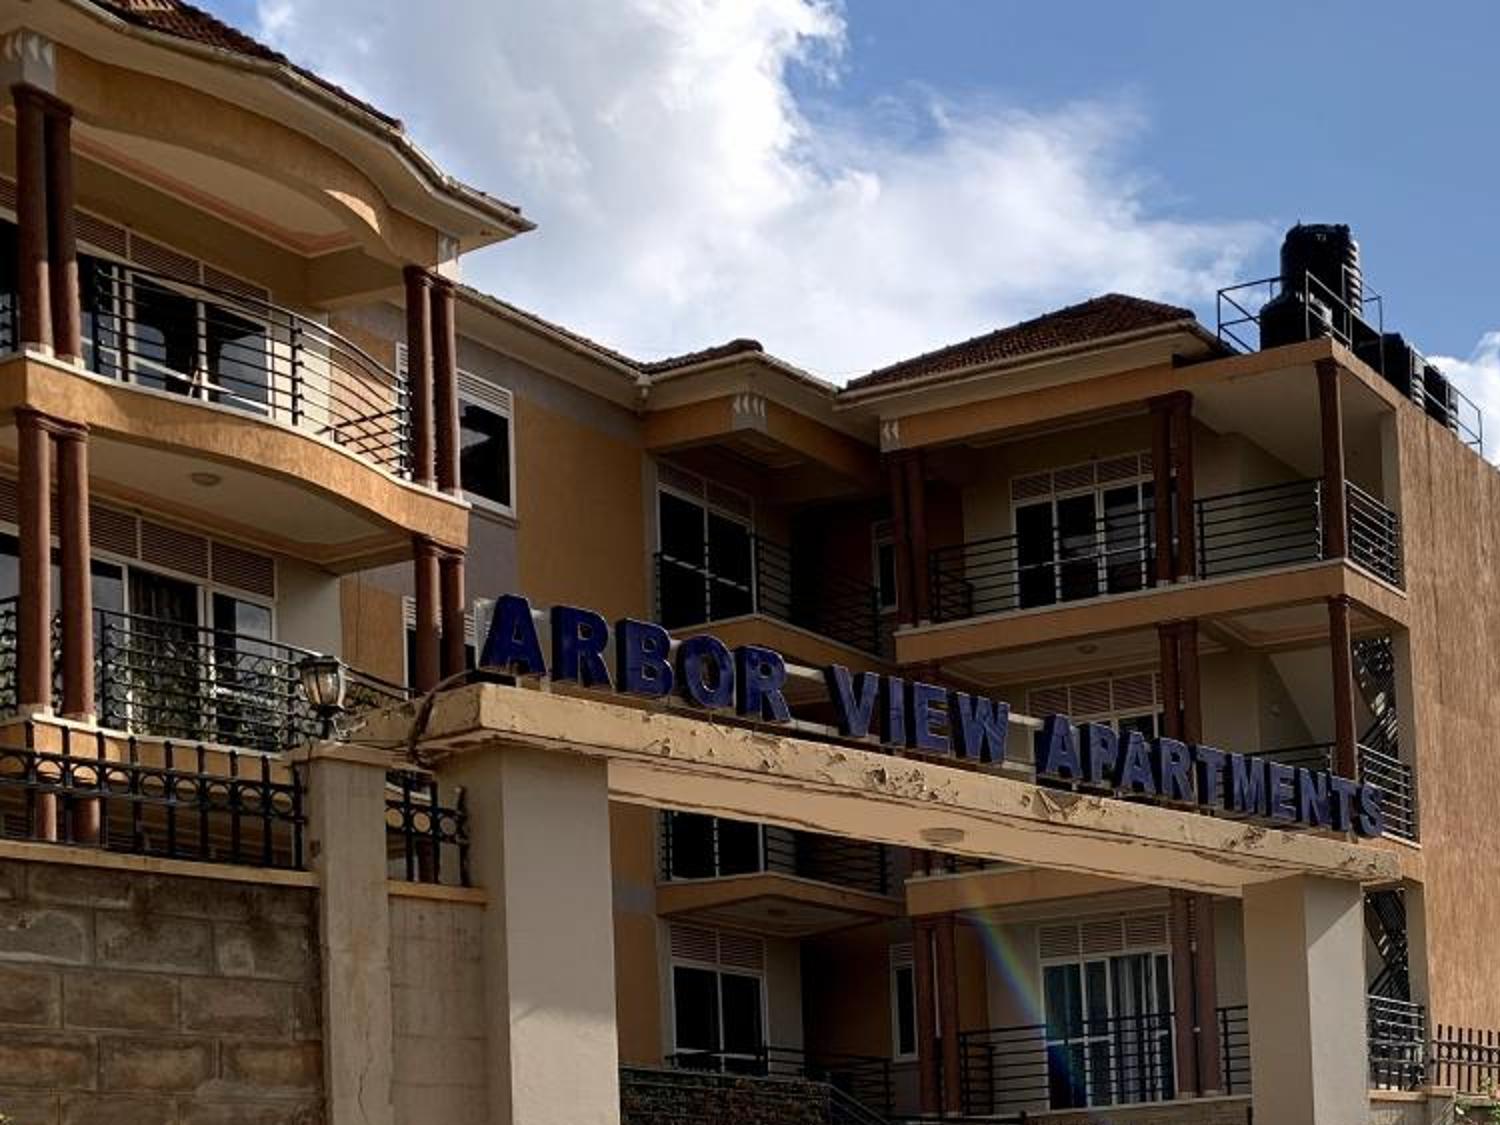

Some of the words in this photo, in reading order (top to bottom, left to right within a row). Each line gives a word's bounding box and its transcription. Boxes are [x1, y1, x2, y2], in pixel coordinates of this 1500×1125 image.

[479, 593, 792, 724] ARBOR
[825, 663, 1010, 764] VIEW
[1036, 713, 1385, 839] APARTMENTS
